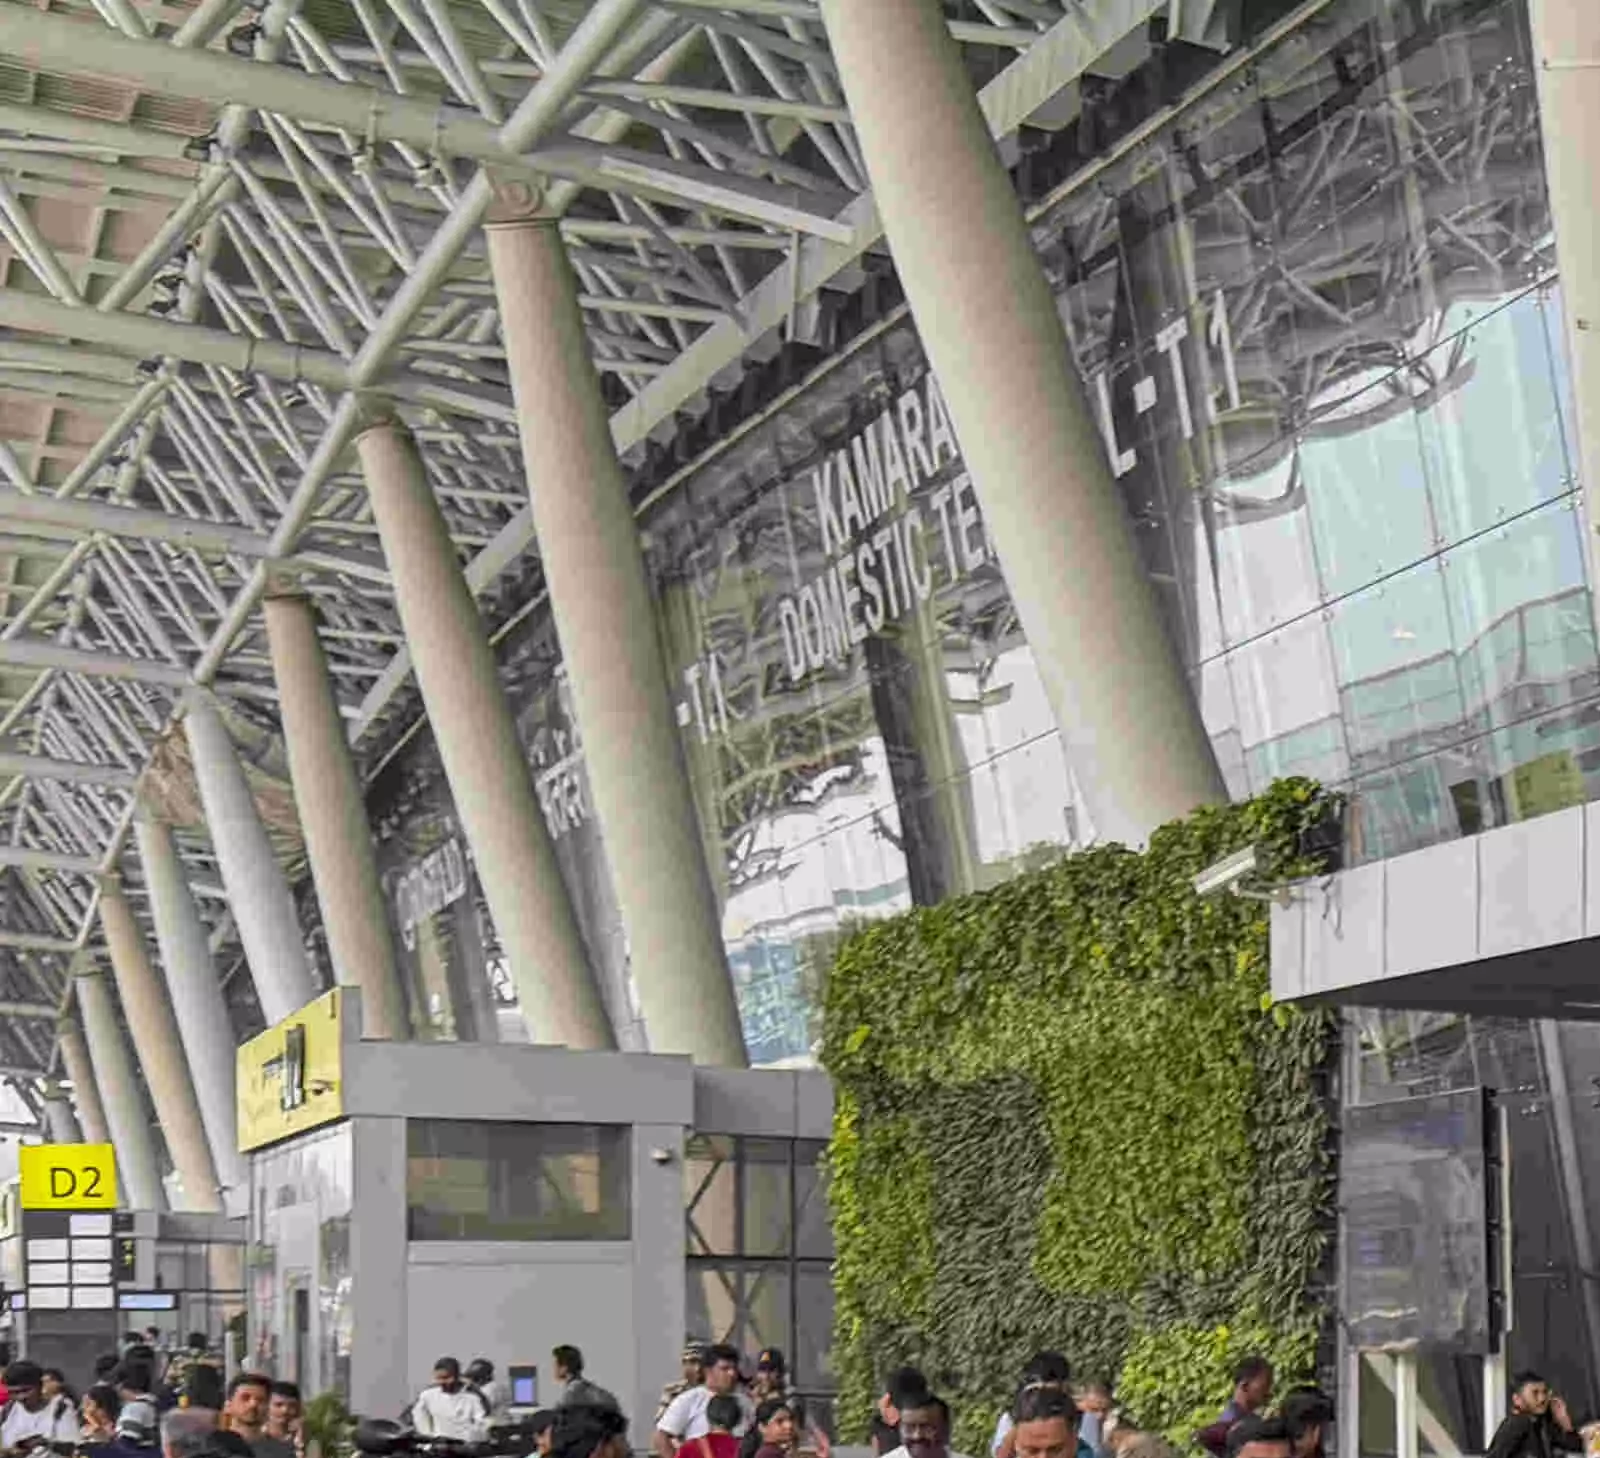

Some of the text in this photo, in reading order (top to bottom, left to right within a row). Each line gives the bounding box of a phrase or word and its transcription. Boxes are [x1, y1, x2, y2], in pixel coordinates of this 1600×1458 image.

[813, 368, 957, 556] KAMARA
[779, 508, 932, 682] DOMESTIC
[930, 472, 1000, 582] TE
[50, 1166, 104, 1199] D2
